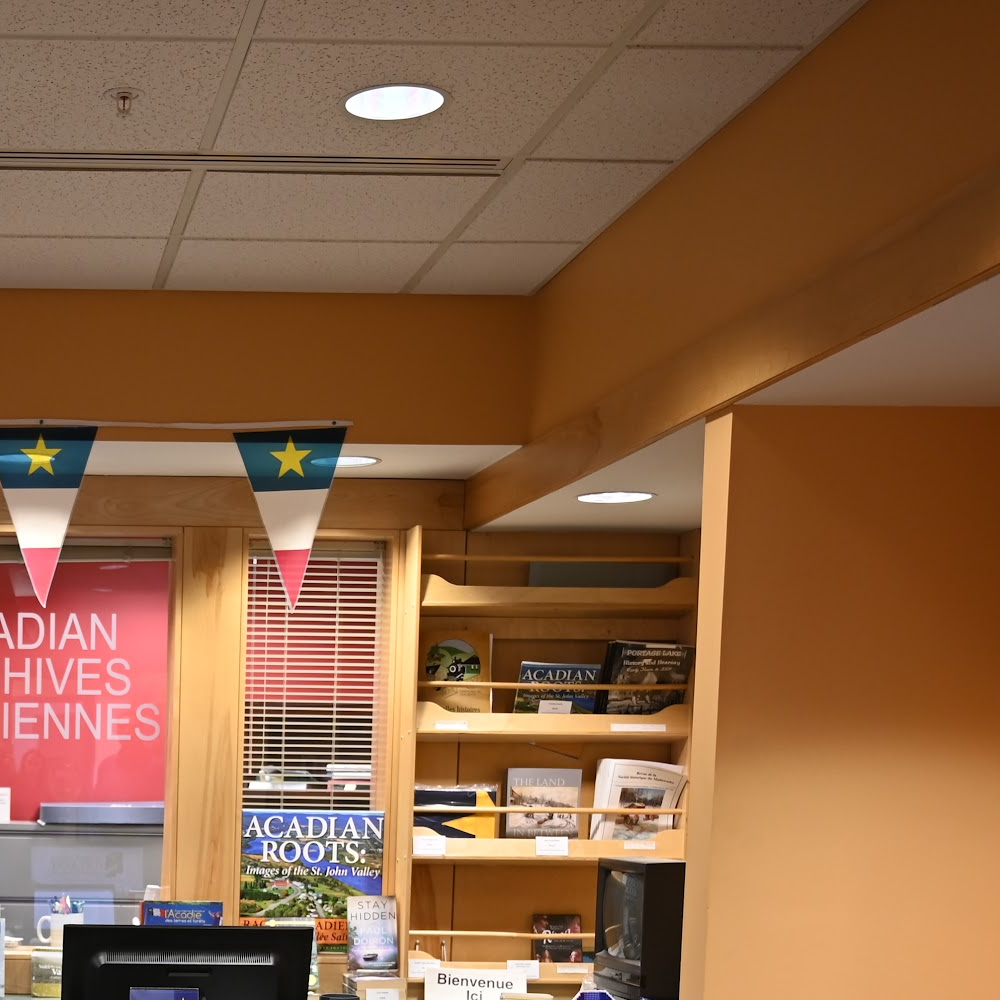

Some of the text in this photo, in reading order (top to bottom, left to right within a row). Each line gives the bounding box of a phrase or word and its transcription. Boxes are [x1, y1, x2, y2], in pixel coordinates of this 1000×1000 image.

[626, 649, 661, 657] PORTAGE
[522, 669, 597, 681] ACADIAN
[512, 778, 566, 787] THE LAND
[243, 815, 384, 840] ACADIAN
[513, 828, 575, 837] IN BETWEEN
[260, 840, 366, 865] ROOTS:
[246, 865, 381, 880] Images of the St. John Valley
[357, 900, 388, 910] STAY
[350, 911, 396, 921] HIDDEN
[360, 926, 388, 935] PAUL
[353, 937, 394, 946] DOIRON
[437, 973, 514, 990] Bienvenue
